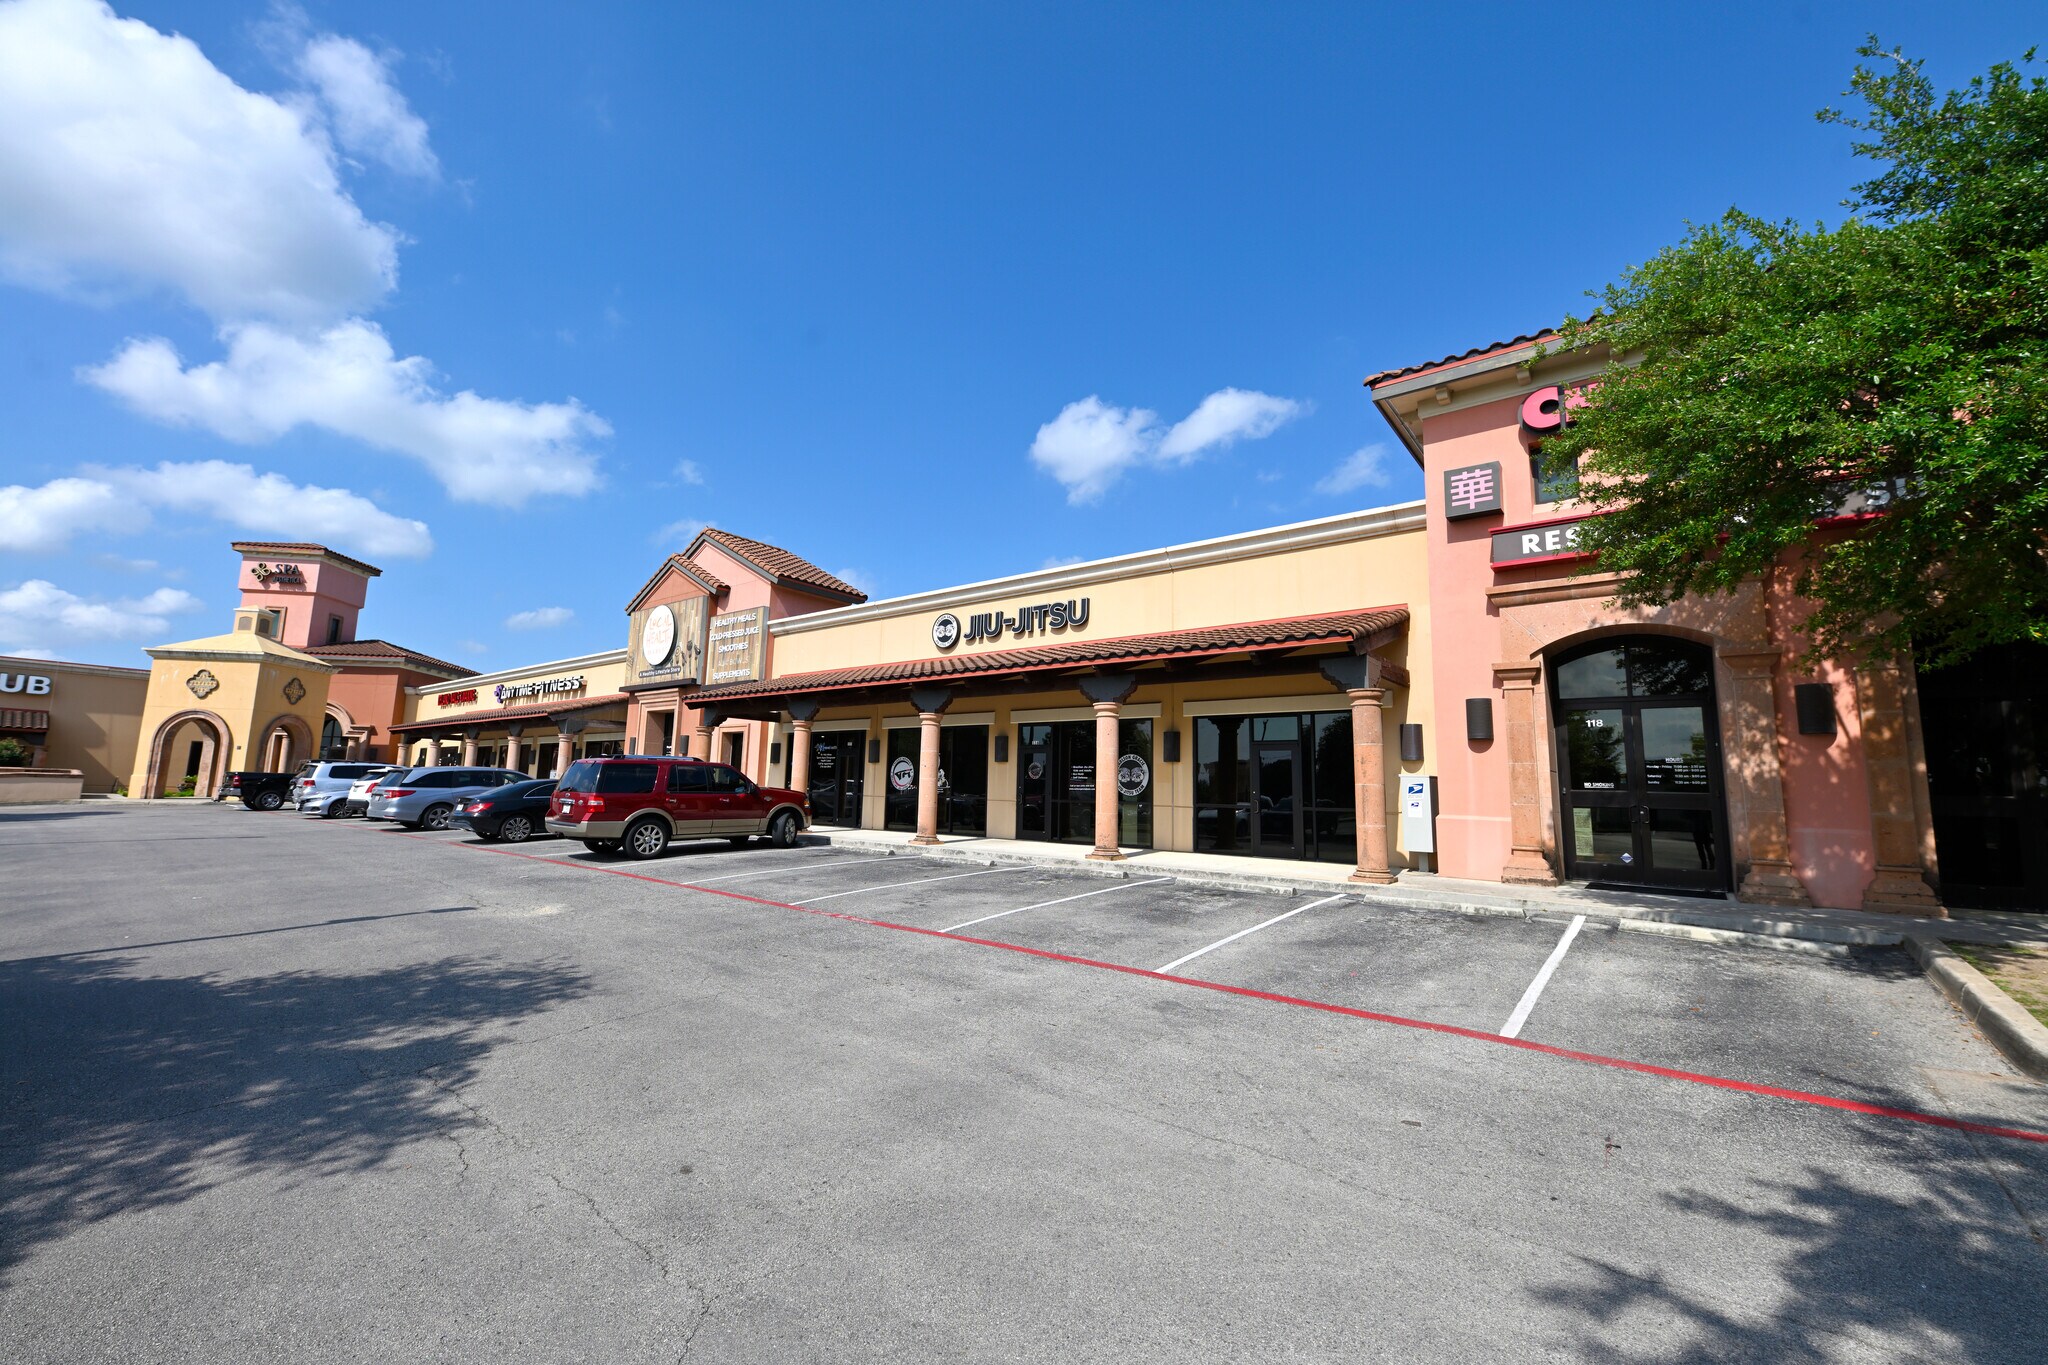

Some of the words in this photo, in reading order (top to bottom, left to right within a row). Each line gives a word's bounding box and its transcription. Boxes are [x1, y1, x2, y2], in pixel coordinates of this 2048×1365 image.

[1450, 468, 1493, 510] 華
[275, 563, 300, 575] SPA
[649, 613, 673, 631] LOCAL
[715, 615, 738, 627] HEALTHY
[738, 612, 757, 622] MEALS
[963, 597, 1091, 641] JIU-JITSU
[718, 642, 749, 653] SMOOTHIES
[712, 668, 751, 680] SUPPLEMENTS
[500, 684, 533, 700] ANYTIME
[534, 675, 583, 694] FITNESS
[1585, 719, 1604, 728] 118
